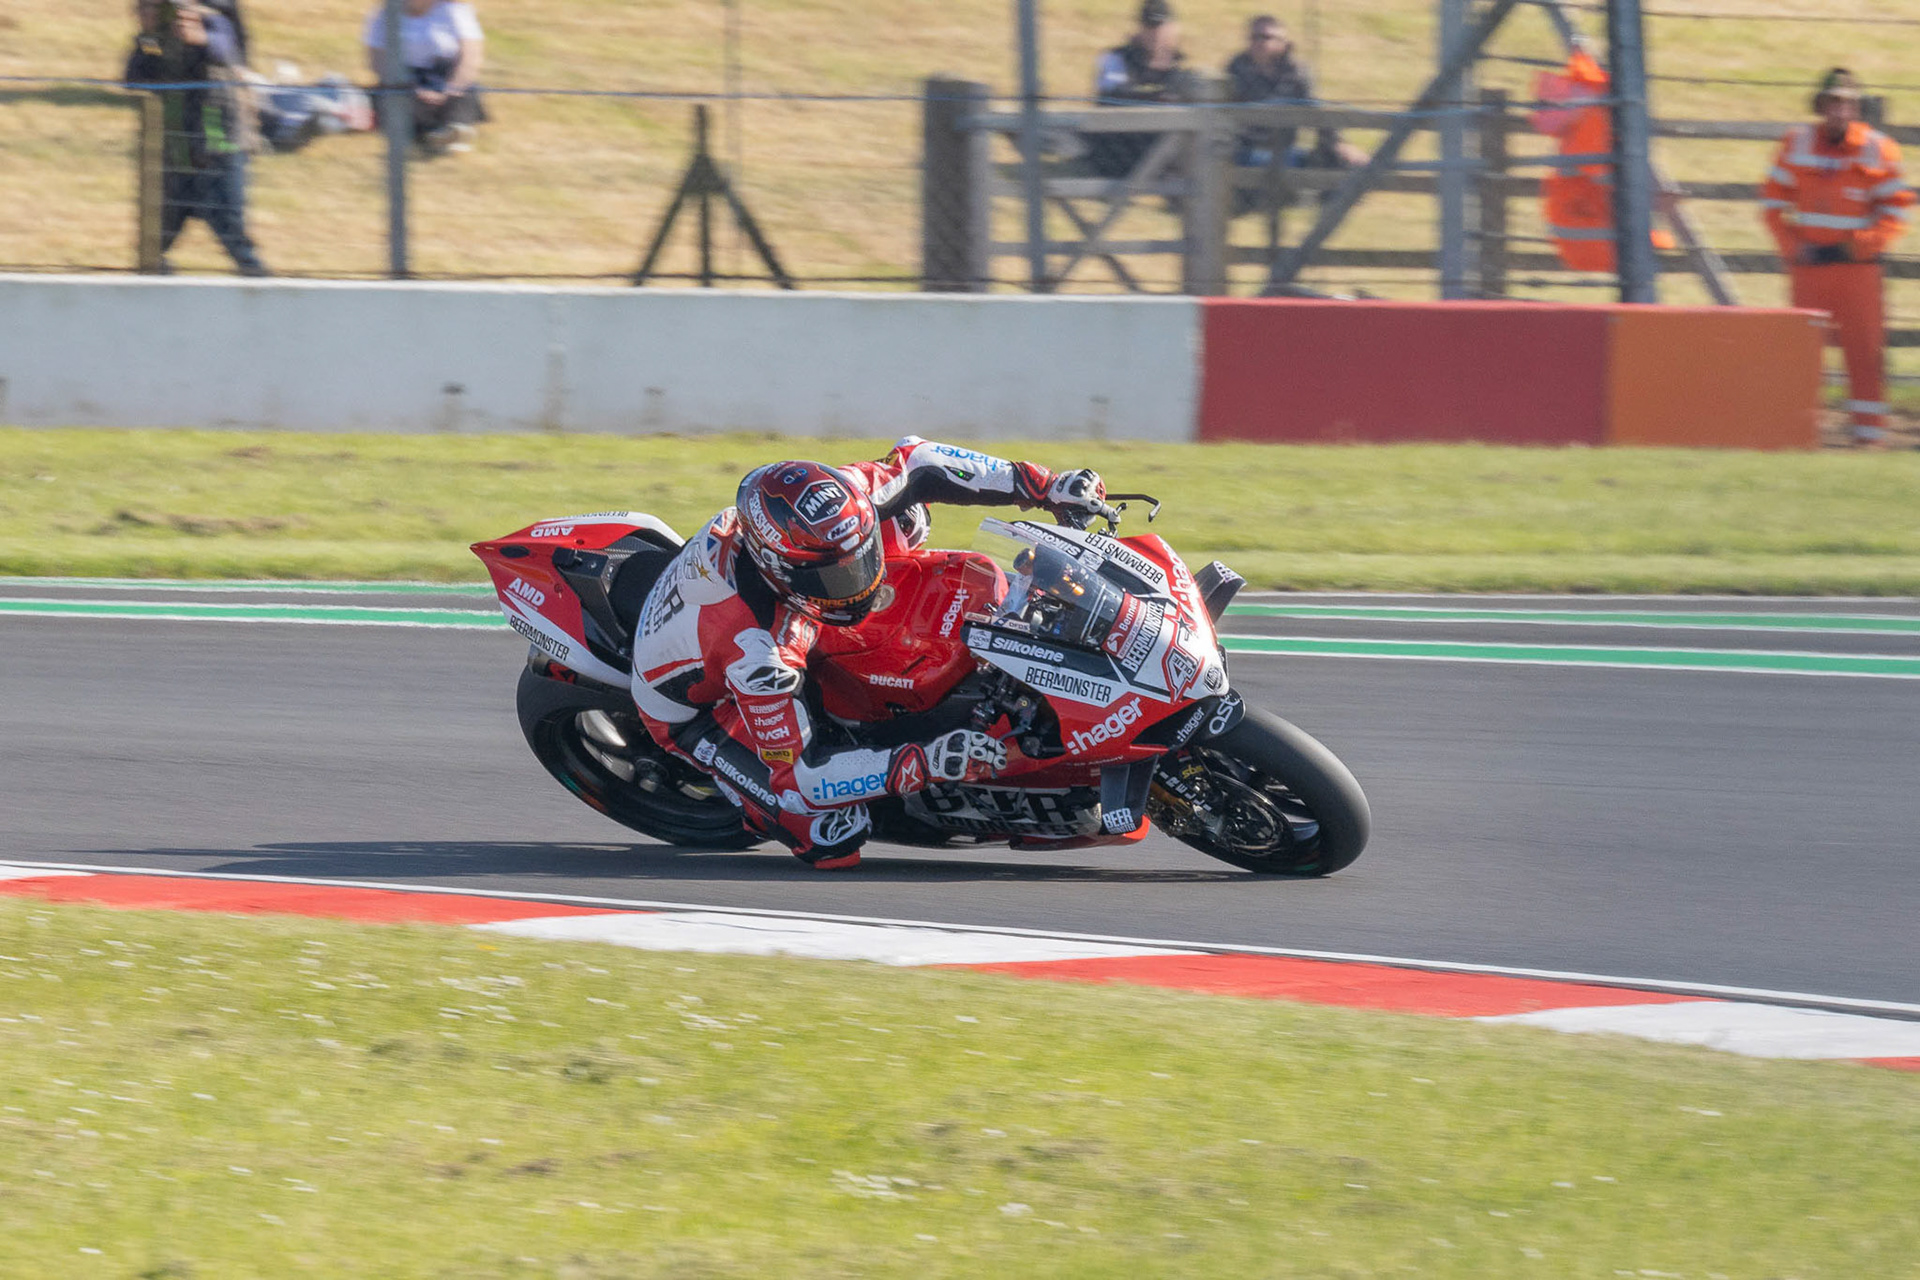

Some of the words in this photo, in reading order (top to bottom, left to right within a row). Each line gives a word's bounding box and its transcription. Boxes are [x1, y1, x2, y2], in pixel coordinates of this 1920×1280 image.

[805, 486, 842, 517] MINT
[530, 526, 574, 538] AMD
[1085, 533, 1164, 584] BEERMONSTER
[508, 577, 545, 606] AMD
[510, 615, 570, 660] BEERMONSTER
[1009, 621, 1029, 630] DFDS
[1121, 601, 1164, 673] BEERMONSTER
[1173, 657, 1193, 676] OLLIE
[870, 674, 914, 690] DUCATI
[1025, 667, 1111, 703] BEERMONSTER
[1067, 696, 1144, 755] :hager
[1102, 808, 1134, 828] BEER
